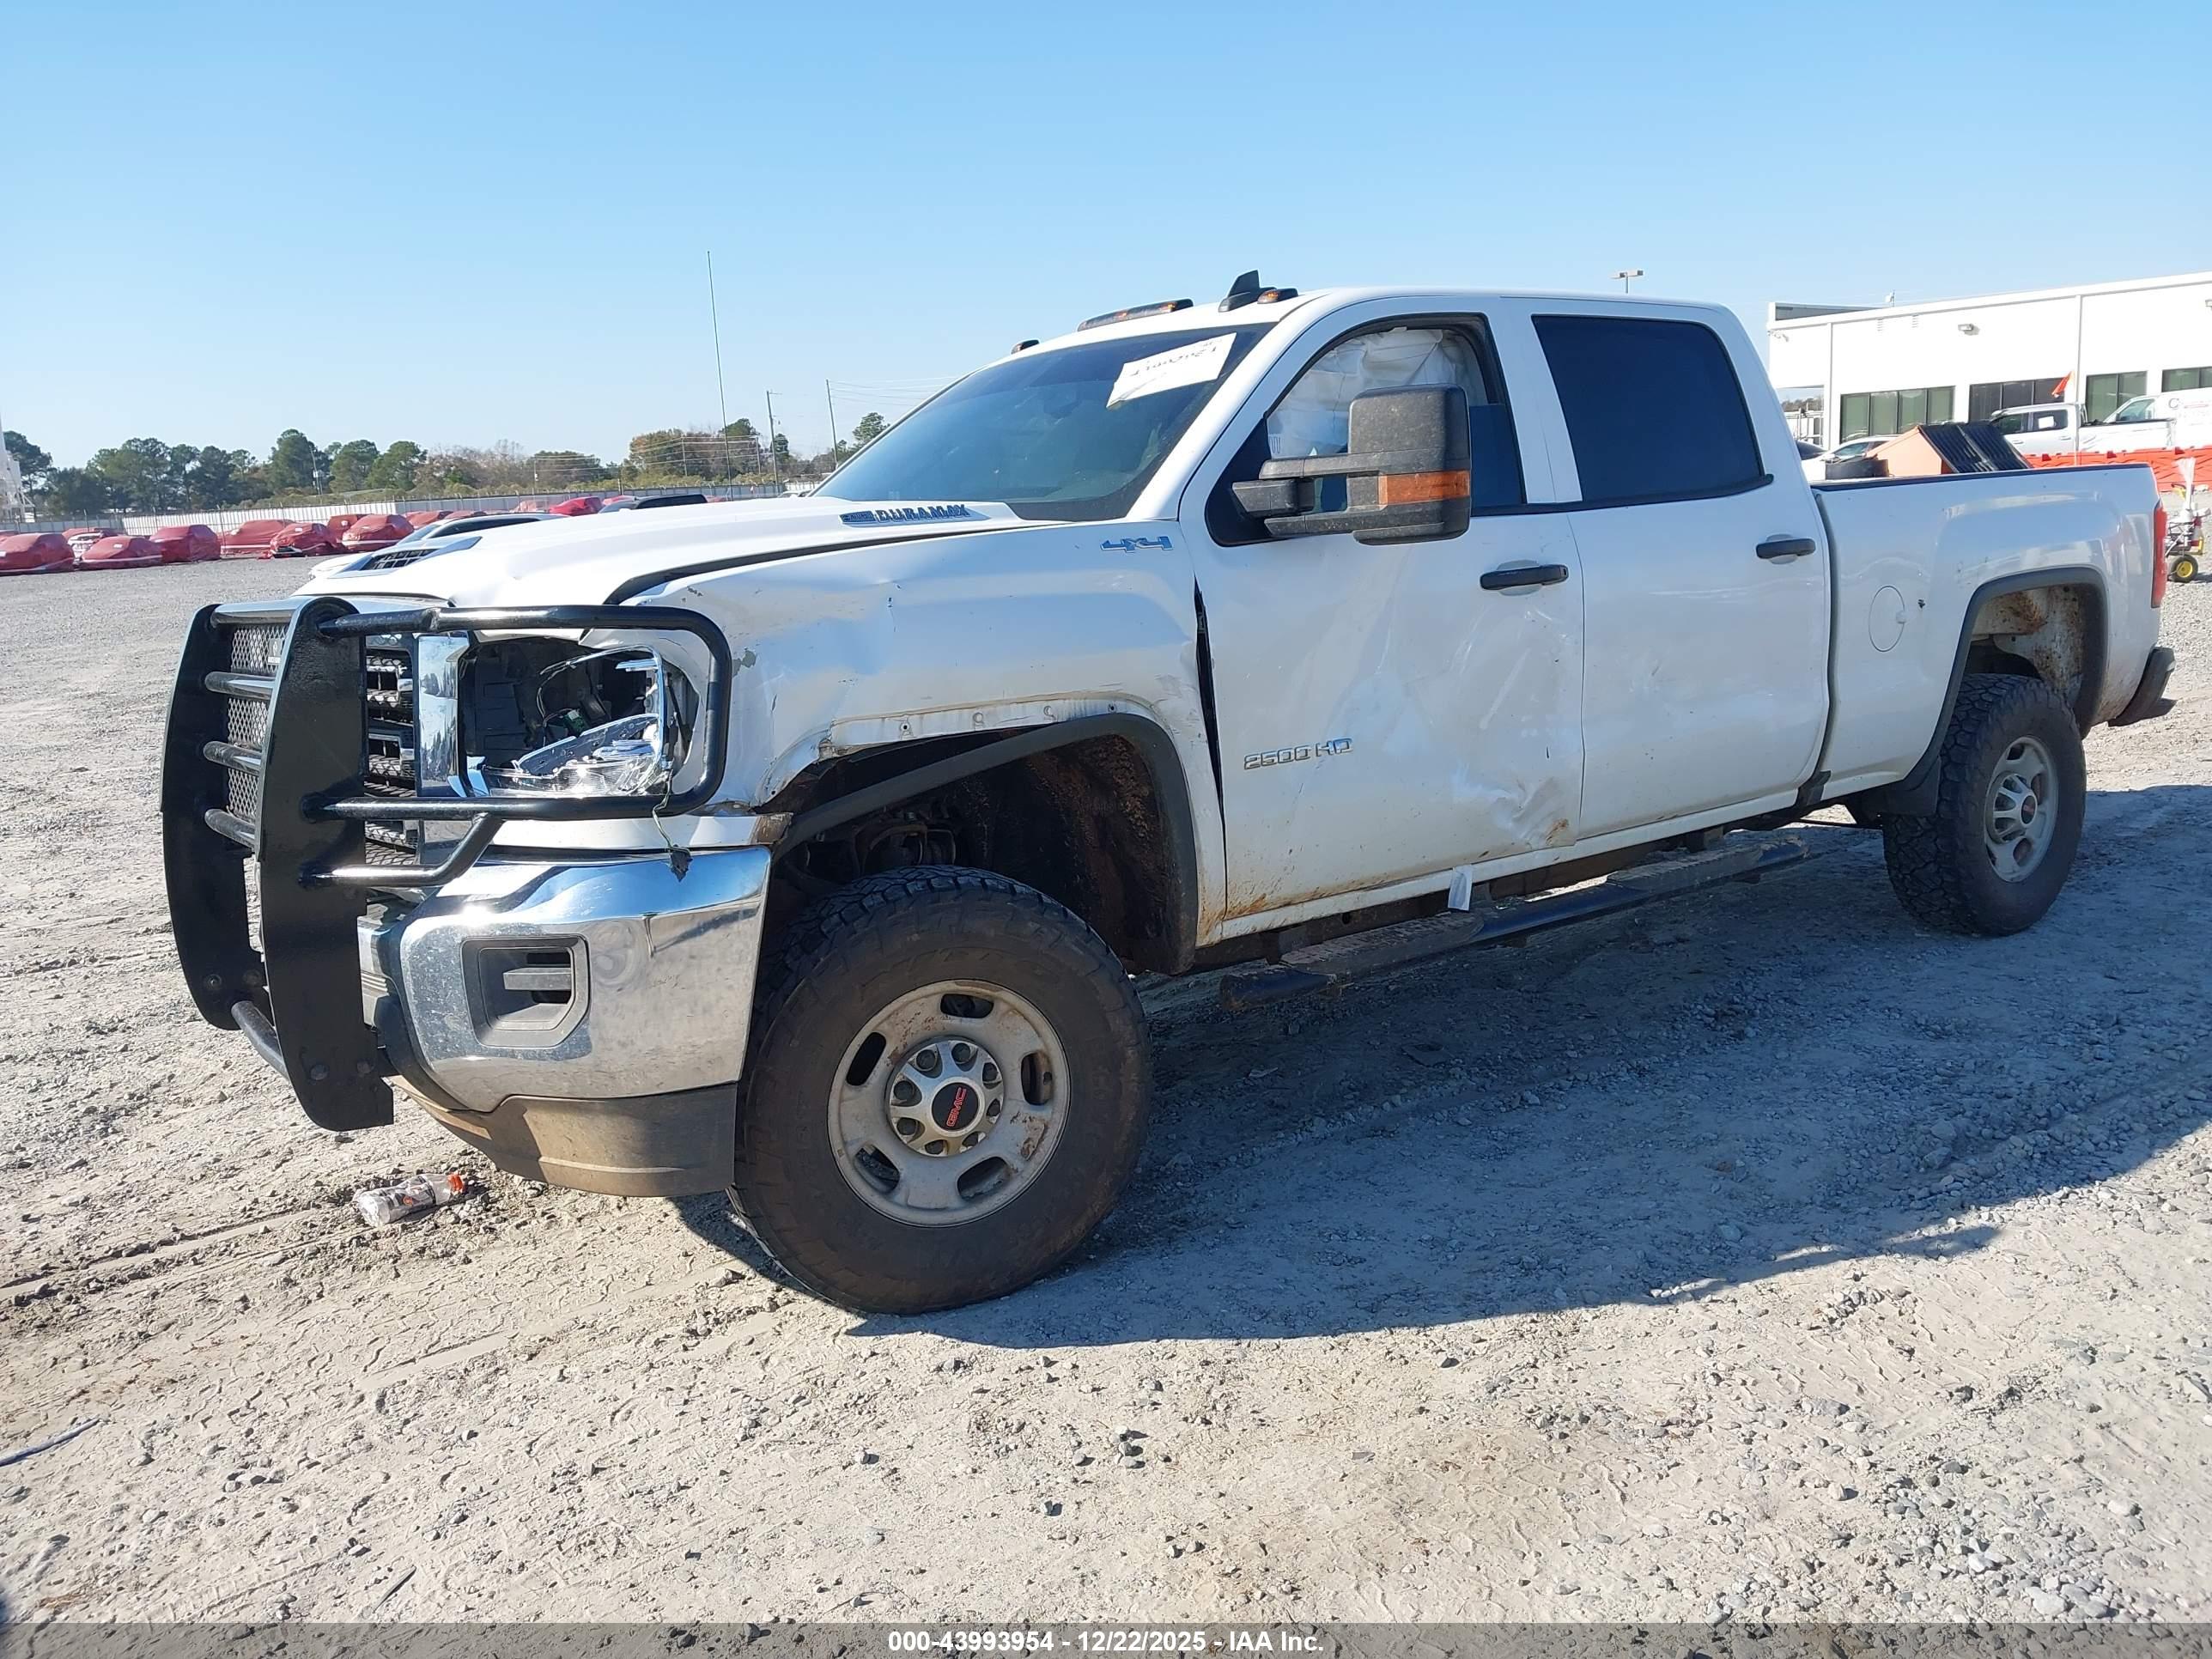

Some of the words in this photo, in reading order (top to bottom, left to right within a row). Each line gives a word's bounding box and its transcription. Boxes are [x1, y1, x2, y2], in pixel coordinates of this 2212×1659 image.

[874, 503, 970, 523] DURAMAX
[1244, 744, 1311, 769] 2500
[1316, 738, 1353, 757] HD
[946, 1086, 967, 1127] GMC
